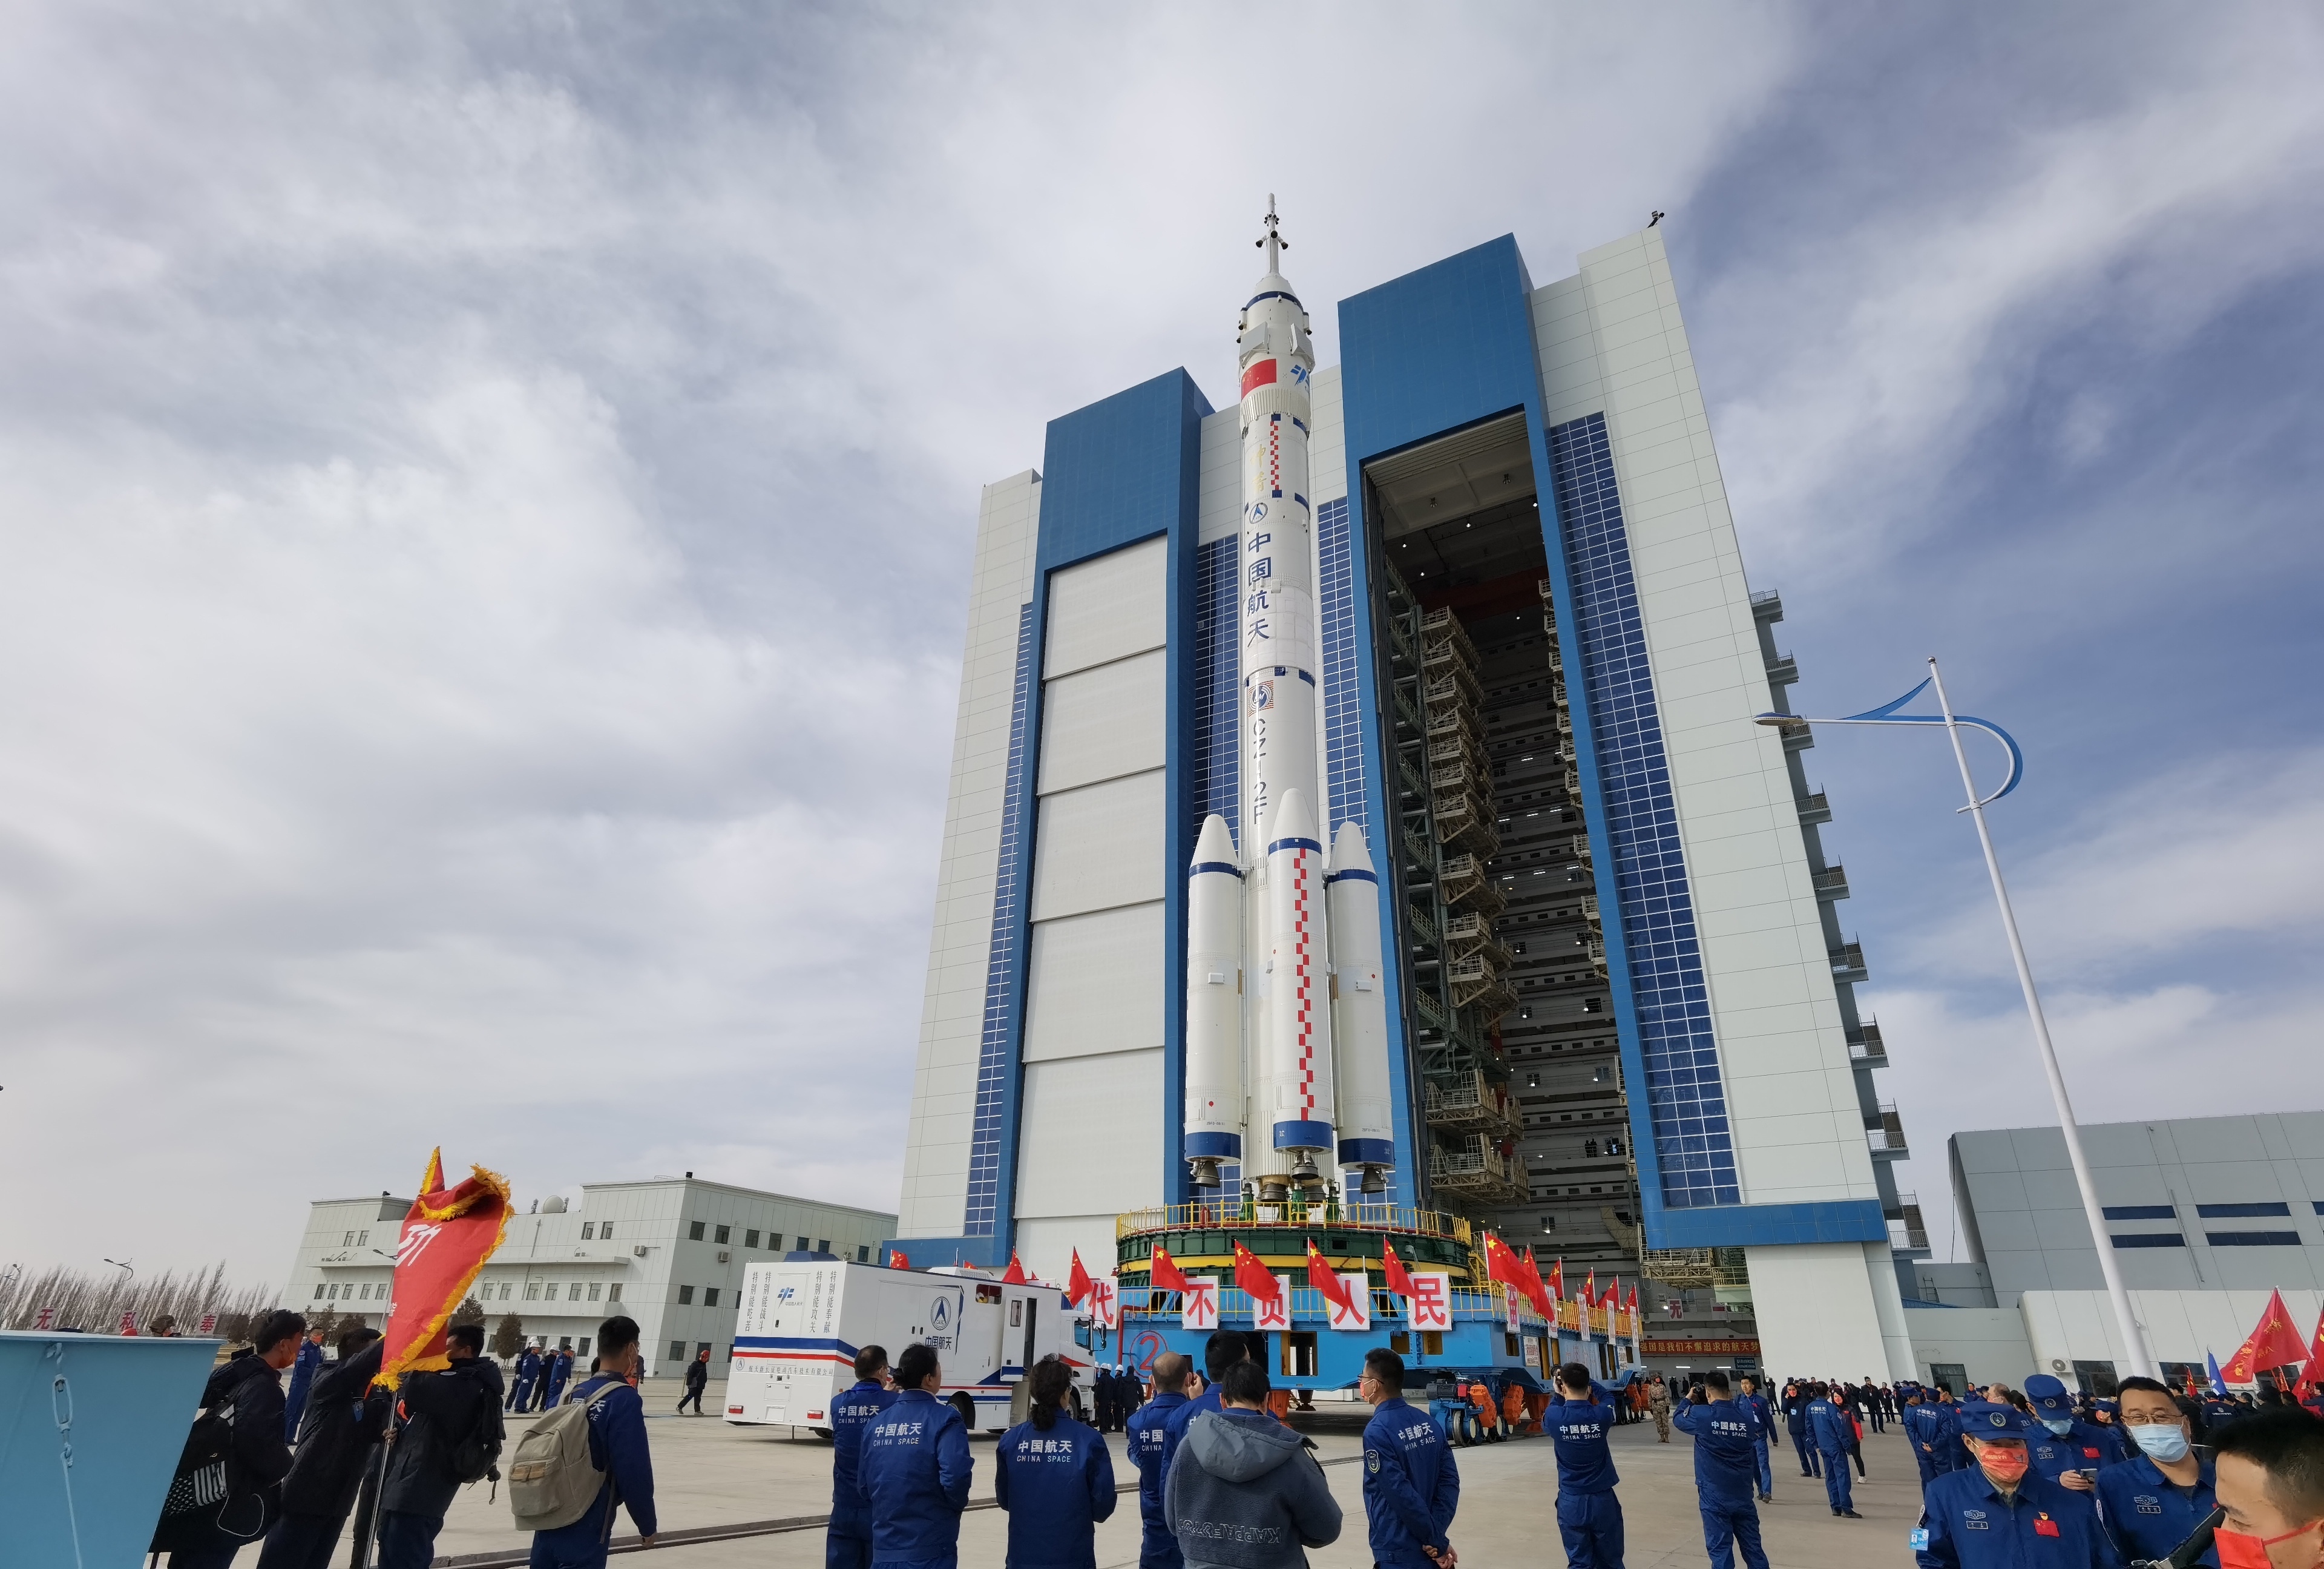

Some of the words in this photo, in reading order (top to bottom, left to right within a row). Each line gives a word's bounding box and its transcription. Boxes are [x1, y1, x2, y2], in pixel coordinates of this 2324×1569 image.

[1247, 532, 1271, 647] 中国航天
[746, 1271, 758, 1332] 特别能吃苦
[758, 1271, 771, 1332] 特别能战斗
[809, 1271, 823, 1333] 特别能攻关
[824, 1271, 837, 1333] 特别能奉献
[1670, 1300, 1682, 1319] 无
[35, 1309, 53, 1329] 无
[199, 1315, 216, 1333] 奉
[925, 1336, 952, 1350] 中国航天
[838, 1405, 880, 1416] 中国航天
[875, 1423, 922, 1437] 中国航天
[1140, 1429, 1163, 1442] 中国
[1398, 1422, 1433, 1442] 中国航天
[1559, 1423, 1601, 1434] 中国航天
[1712, 1421, 1747, 1431] 中国航天
[1018, 1439, 1072, 1453] 中国航天
